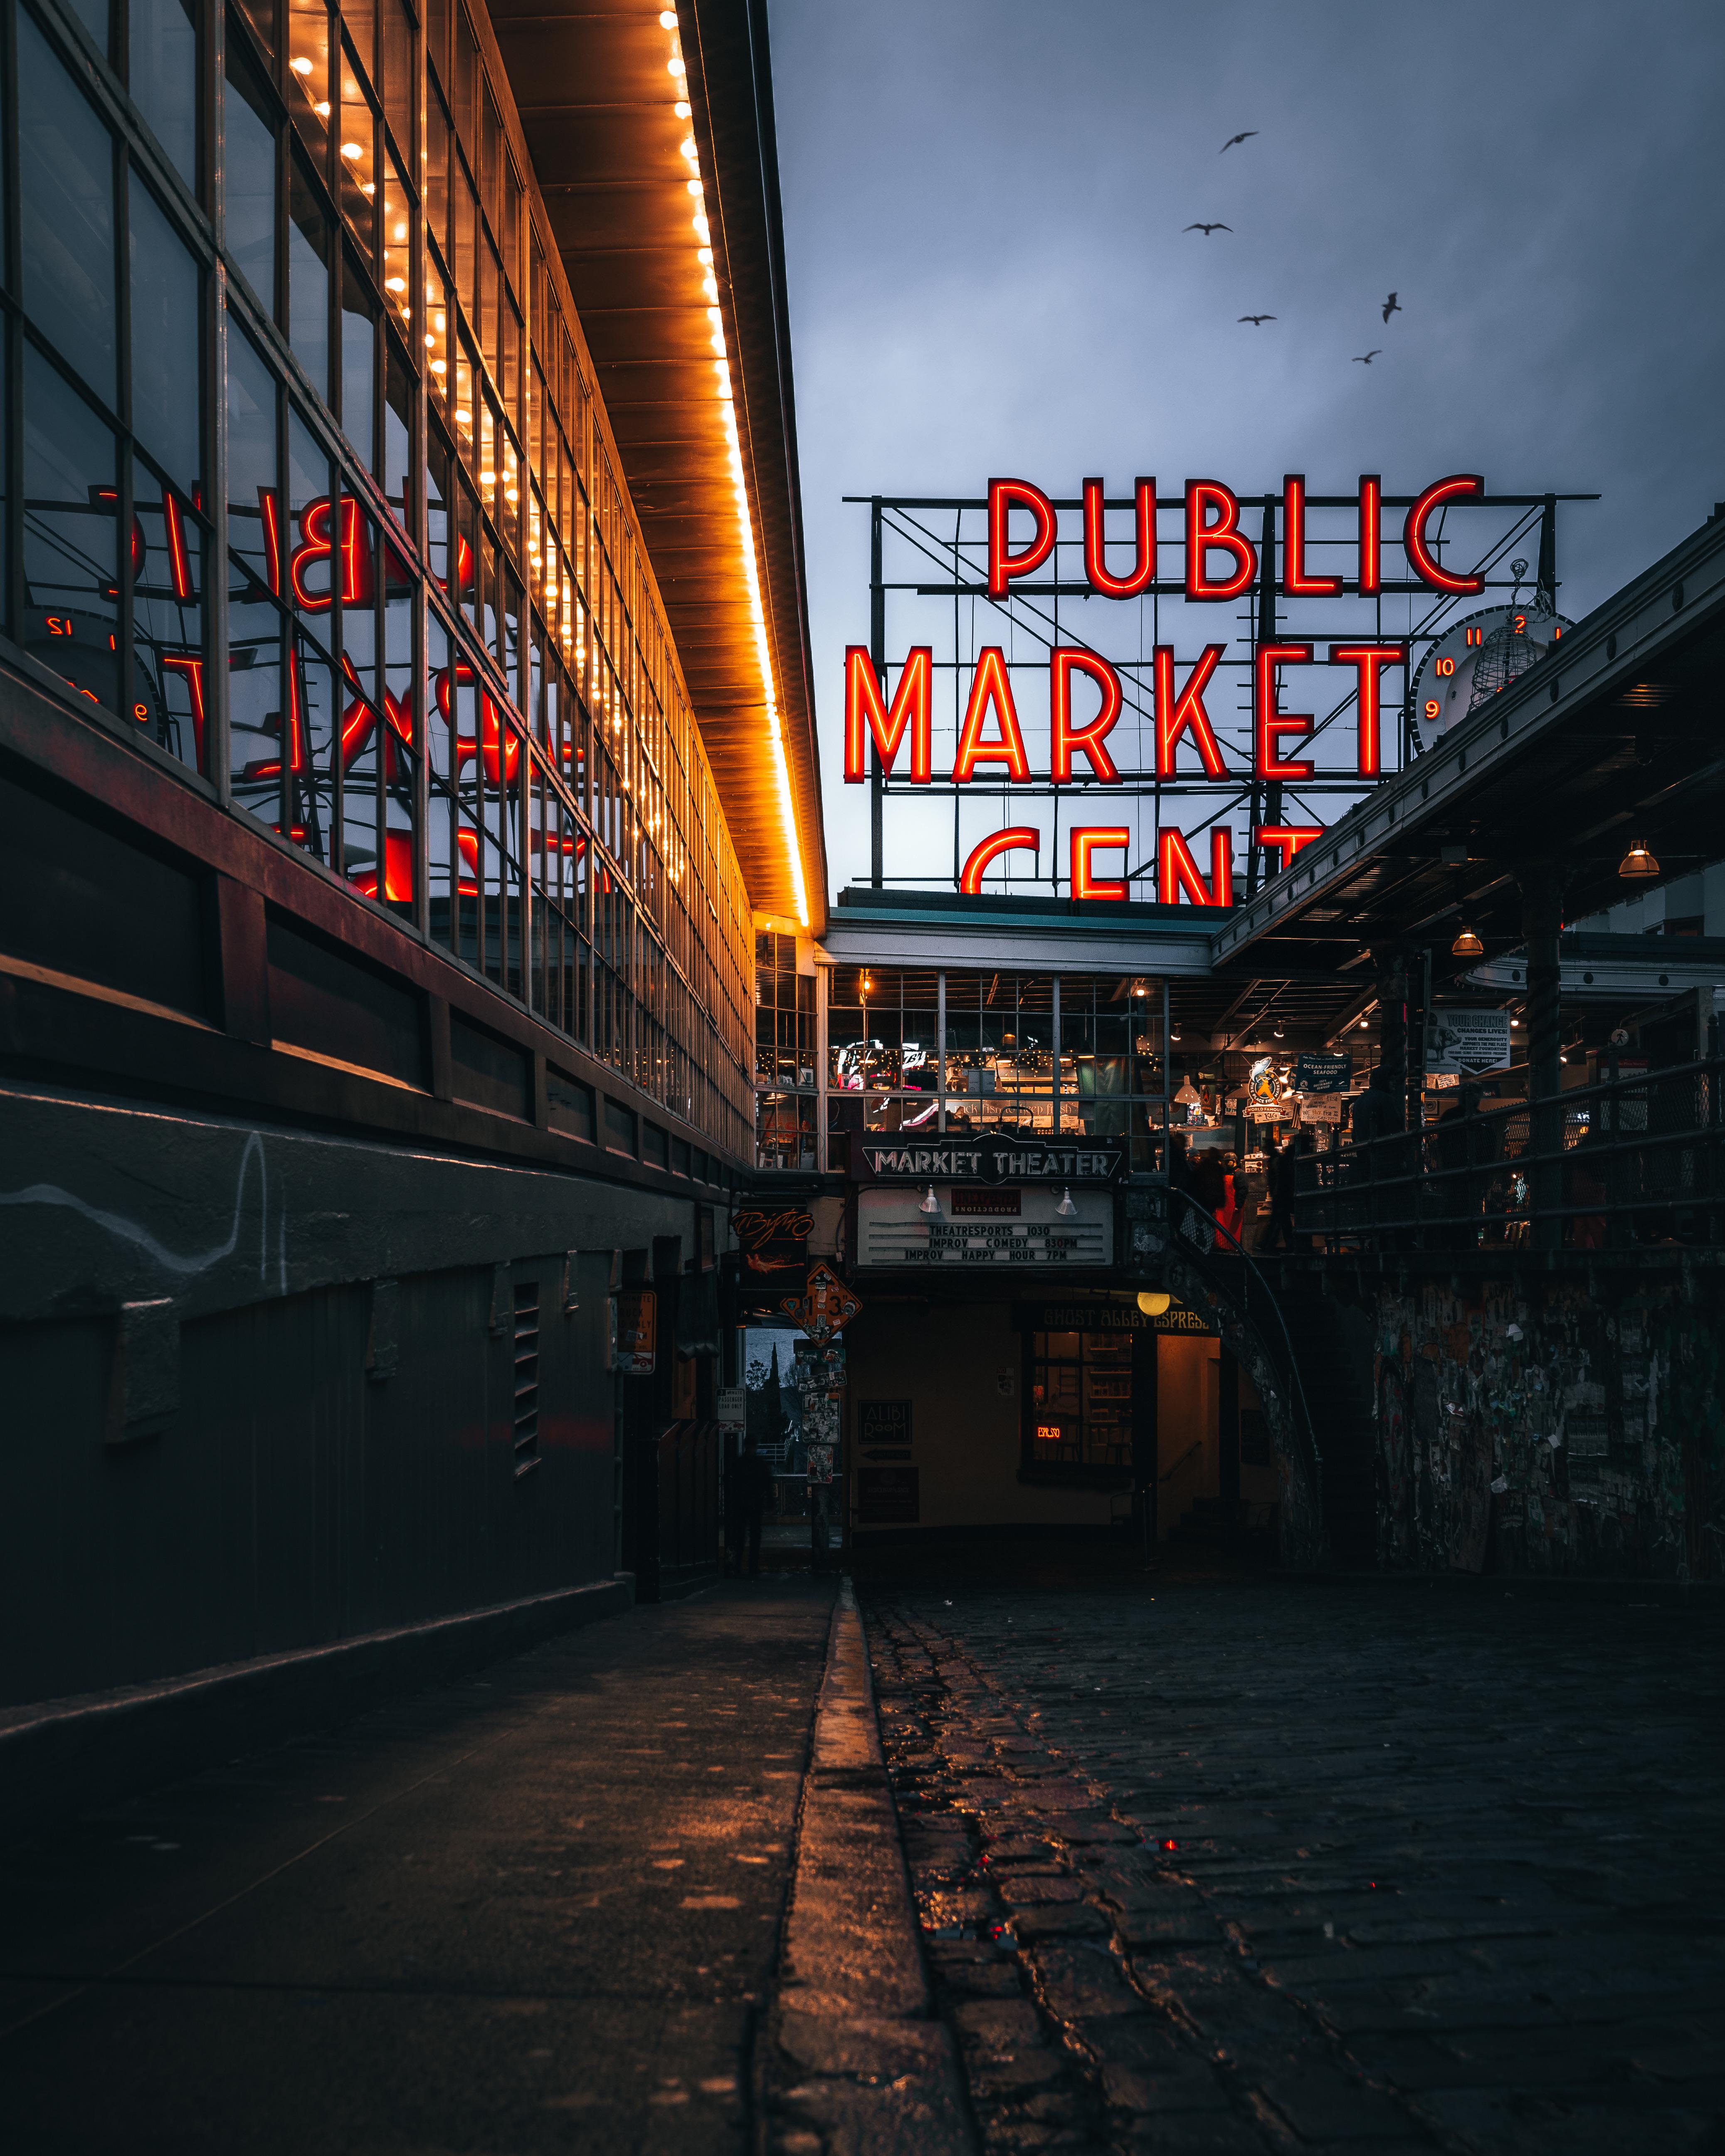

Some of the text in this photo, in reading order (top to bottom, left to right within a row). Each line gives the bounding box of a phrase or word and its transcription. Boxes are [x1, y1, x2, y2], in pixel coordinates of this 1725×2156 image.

[987, 474, 1485, 602] PUBLIC
[1466, 627, 1481, 646] 11
[1436, 657, 1455, 676] 10
[844, 643, 1409, 784] MARKET
[1425, 700, 1440, 719] 9
[1447, 1014, 1508, 1028] YOUR CHANGE
[1252, 1094, 1264, 1103] PLACE
[875, 1151, 1109, 1176] MARKET THEATER
[930, 1226, 1050, 1235] THEATRESPORTS 1030
[930, 1238, 1077, 1248] IMPROV COMEDY 830PM
[905, 1250, 1067, 1260] IMPROV HAPPY HOUR 7PM
[619, 1309, 644, 1317] RUCK
[1044, 1309, 1095, 1326] GHOST
[1100, 1310, 1150, 1327] ALLEY
[866, 1405, 905, 1420] ALIBI
